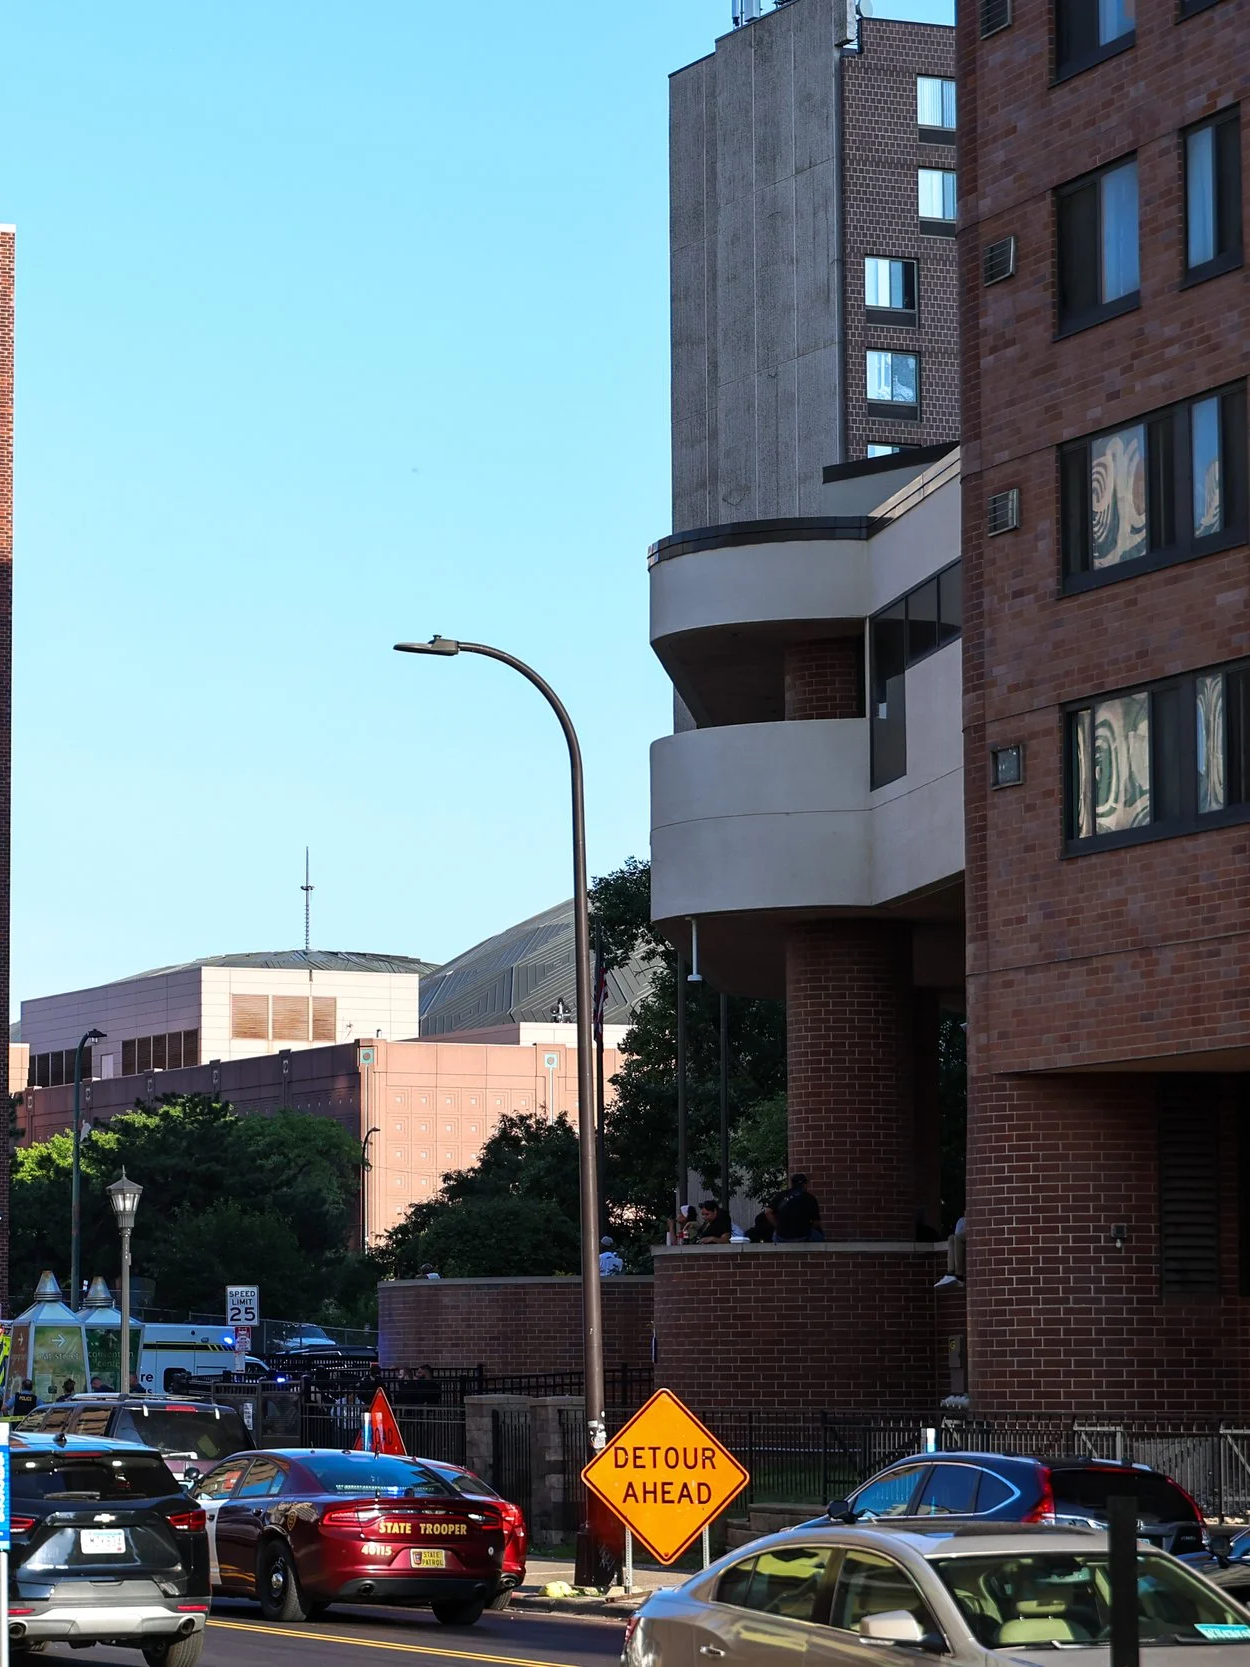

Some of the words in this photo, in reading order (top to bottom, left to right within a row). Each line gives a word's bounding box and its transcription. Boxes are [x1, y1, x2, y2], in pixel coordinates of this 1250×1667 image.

[229, 1290, 256, 1298] SPEED
[231, 1298, 253, 1306] LIMIT
[229, 1307, 256, 1322] 25
[613, 1446, 717, 1470] DETOUR
[622, 1481, 712, 1505] AHEAD
[378, 1522, 412, 1534] STATE
[419, 1523, 467, 1535] TROOPER
